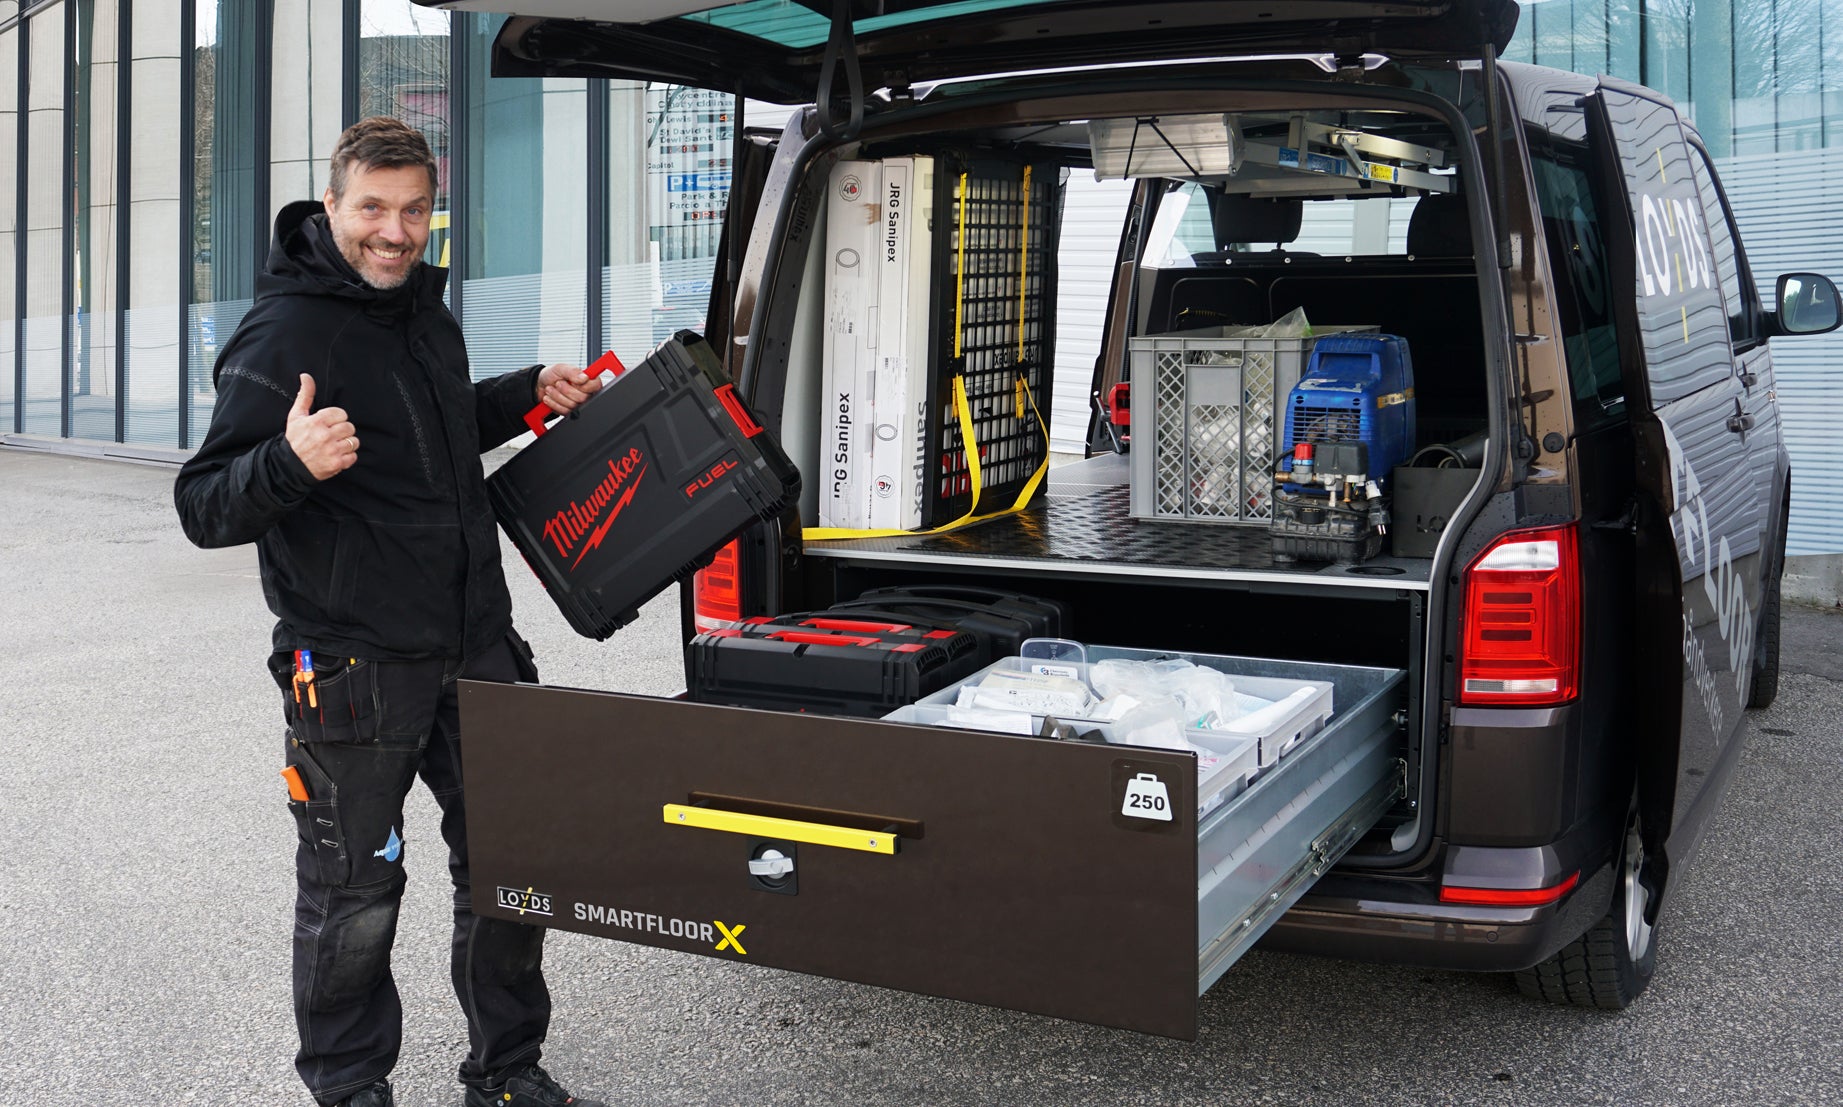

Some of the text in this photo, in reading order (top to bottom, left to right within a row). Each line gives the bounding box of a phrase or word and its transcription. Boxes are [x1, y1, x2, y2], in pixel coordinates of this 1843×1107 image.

[666, 115, 692, 123] Lewis
[659, 127, 712, 136] St David's
[684, 134, 714, 142] Sant
[681, 193, 705, 201] Park
[886, 182, 900, 262] JRG Sanipex
[835, 392, 852, 464] Sanipex
[685, 459, 739, 499] FUEL
[541, 446, 643, 559] Milwaukee
[1129, 791, 1166, 813] 250
[498, 889, 552, 912] LOYDS
